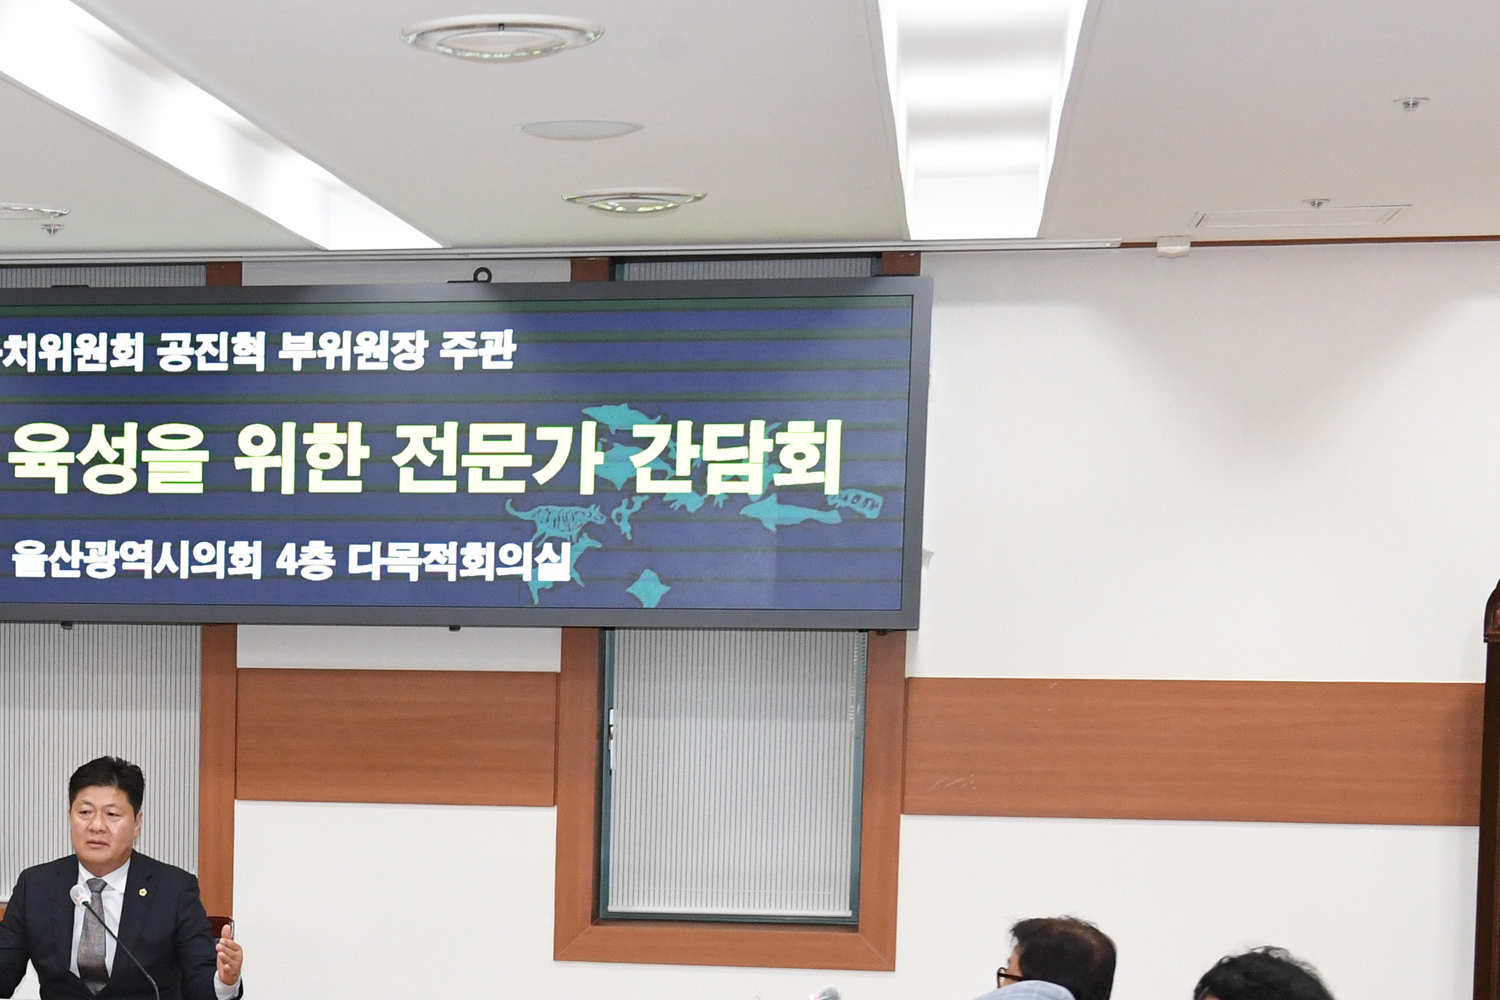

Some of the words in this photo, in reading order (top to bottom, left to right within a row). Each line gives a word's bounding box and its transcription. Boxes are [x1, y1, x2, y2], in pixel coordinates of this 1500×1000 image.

[157, 332, 265, 372] 공진혁
[279, 330, 429, 371] 부위원장
[440, 329, 517, 370] 주관
[8, 422, 209, 494] 육성을
[234, 422, 370, 494] 위한
[392, 421, 604, 495] 전문가
[629, 420, 842, 495] 간담회
[12, 540, 261, 579] 울산광역시의회
[276, 541, 336, 580] 4층
[349, 542, 571, 581] 다목적회의실
